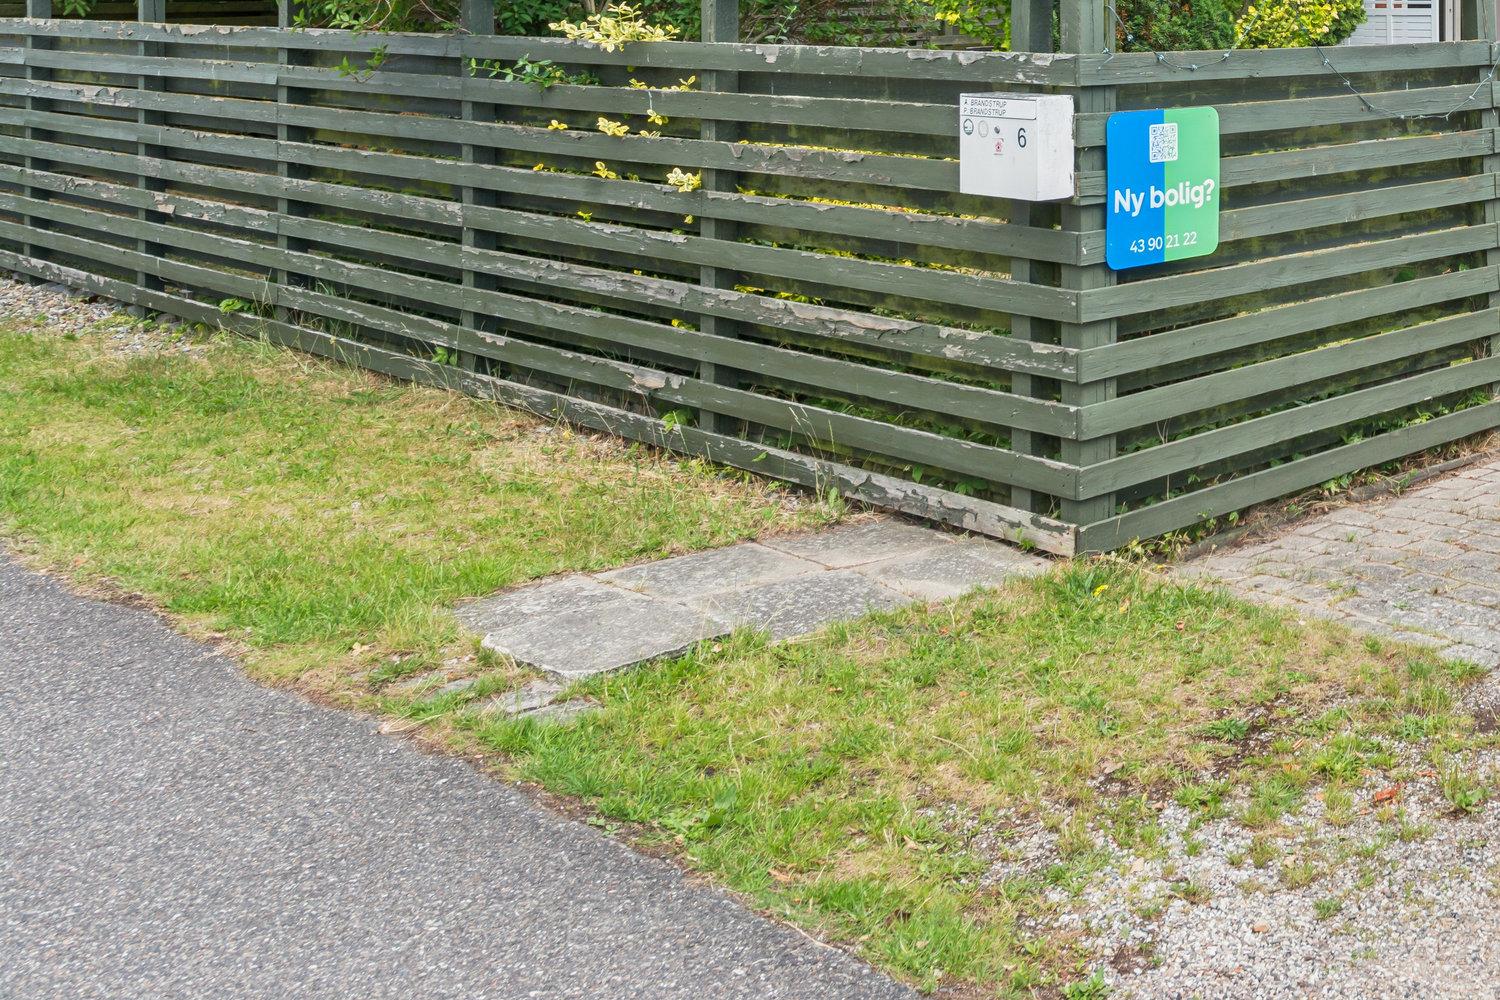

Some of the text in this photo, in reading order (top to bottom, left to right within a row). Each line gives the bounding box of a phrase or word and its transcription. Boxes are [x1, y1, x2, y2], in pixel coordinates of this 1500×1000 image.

[1017, 127, 1027, 148] 6
[1114, 178, 1215, 217] Ny bolig?
[1129, 231, 1197, 253] 43 90 21 22
